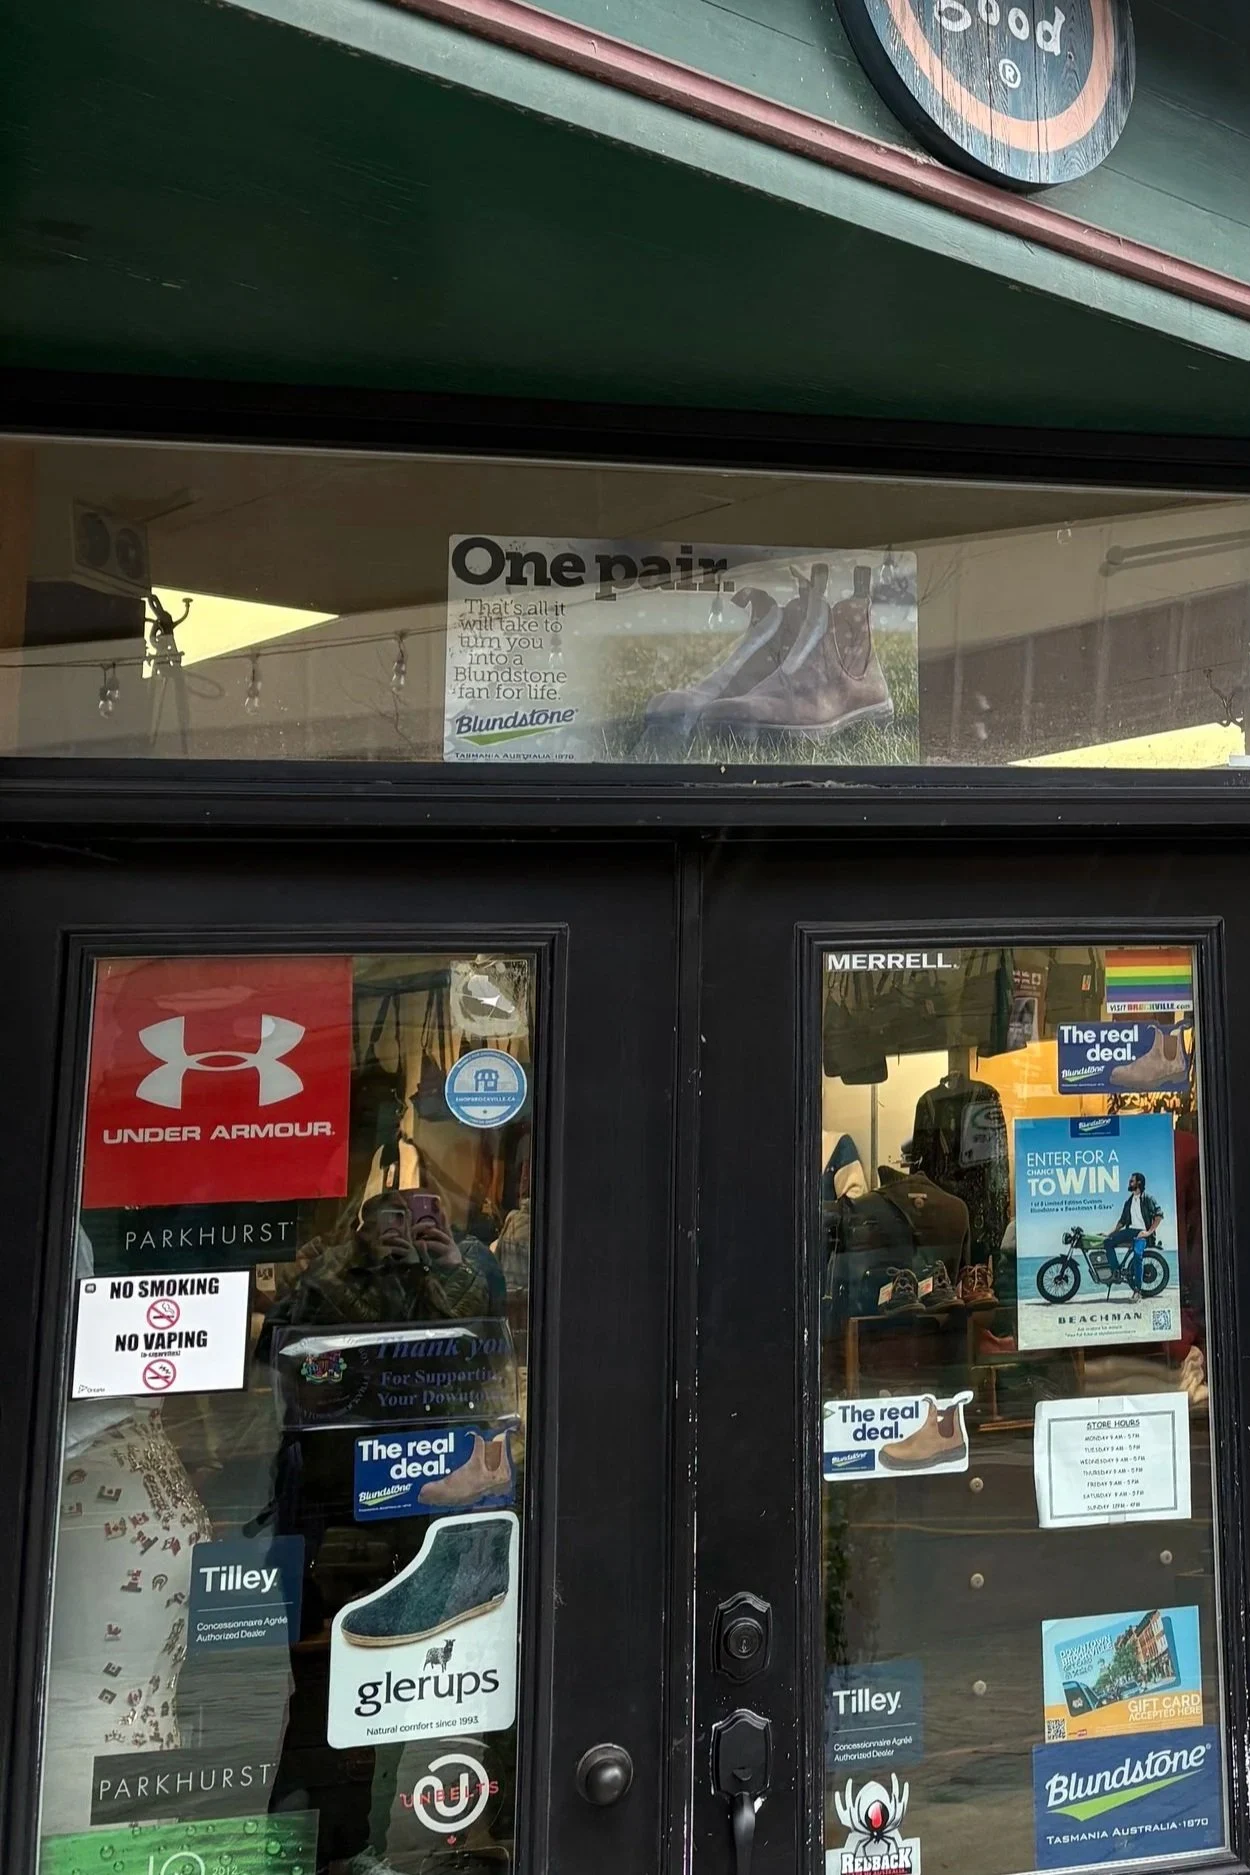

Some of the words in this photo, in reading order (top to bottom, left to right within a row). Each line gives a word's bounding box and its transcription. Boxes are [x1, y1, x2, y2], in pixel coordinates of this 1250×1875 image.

[451, 537, 586, 588] One
[595, 545, 735, 601] pair.
[464, 598, 523, 617] That's
[526, 600, 550, 616] all
[554, 601, 566, 616] it
[459, 617, 495, 632] will
[499, 616, 539, 633] take
[544, 618, 563, 633] to
[460, 634, 501, 649] turn
[507, 636, 543, 650] you
[469, 650, 508, 666] into
[512, 653, 524, 666] a
[454, 667, 568, 685] Blundstone
[457, 684, 490, 700] fan
[495, 683, 523, 700] for
[527, 684, 562, 701] life.
[455, 708, 576, 735] Blundstone
[1060, 1025, 1096, 1044] The
[1100, 1024, 1139, 1043] real
[1086, 1044, 1136, 1062] deal.
[103, 1126, 201, 1145] UNDER
[1027, 1152, 1072, 1167] ENTER
[1075, 1150, 1104, 1166] FOR
[1108, 1149, 1119, 1163] A
[1026, 1168, 1054, 1177] CHANCE
[1028, 1179, 1057, 1197] TO
[1056, 1166, 1120, 1196] WIN
[125, 1221, 290, 1250] PARKHURST
[110, 1281, 134, 1299] NO
[138, 1277, 220, 1298] SMOKING
[1058, 1312, 1143, 1325] BEACHMAN
[115, 1333, 139, 1352] NO
[143, 1330, 208, 1350] VAPING
[379, 1370, 409, 1387] For
[376, 1390, 415, 1408] Your
[838, 1405, 875, 1423] The
[880, 1401, 919, 1420] real
[852, 1421, 904, 1441] deal.
[1087, 1421, 1111, 1430] STORE
[1114, 1419, 1140, 1428] HOURS
[358, 1438, 402, 1462] The
[407, 1432, 455, 1457] real
[390, 1454, 451, 1480] deal.
[358, 1482, 413, 1502] Blundstone
[200, 1565, 278, 1593] Tilley
[196, 1618, 263, 1631] Concessionnaire
[196, 1631, 240, 1642] Authorized
[240, 1629, 266, 1639] Dealer
[354, 1668, 500, 1717] glerups
[832, 1687, 901, 1715] Tilley
[1128, 1698, 1158, 1713] GIFT
[1162, 1694, 1200, 1709] CARD
[1128, 1708, 1176, 1722] ACCEPTED
[1177, 1704, 1200, 1716] HERE
[366, 1725, 398, 1736] Natural
[399, 1721, 433, 1732] comfort
[436, 1719, 457, 1729] since
[834, 1738, 891, 1751] Concessionnaire
[834, 1750, 871, 1762] Authorized
[872, 1749, 895, 1759] Dealer
[99, 1763, 273, 1801] PARKHURST
[1046, 1831, 1108, 1846] TASMANIA
[841, 1847, 913, 1875] REDBACK
